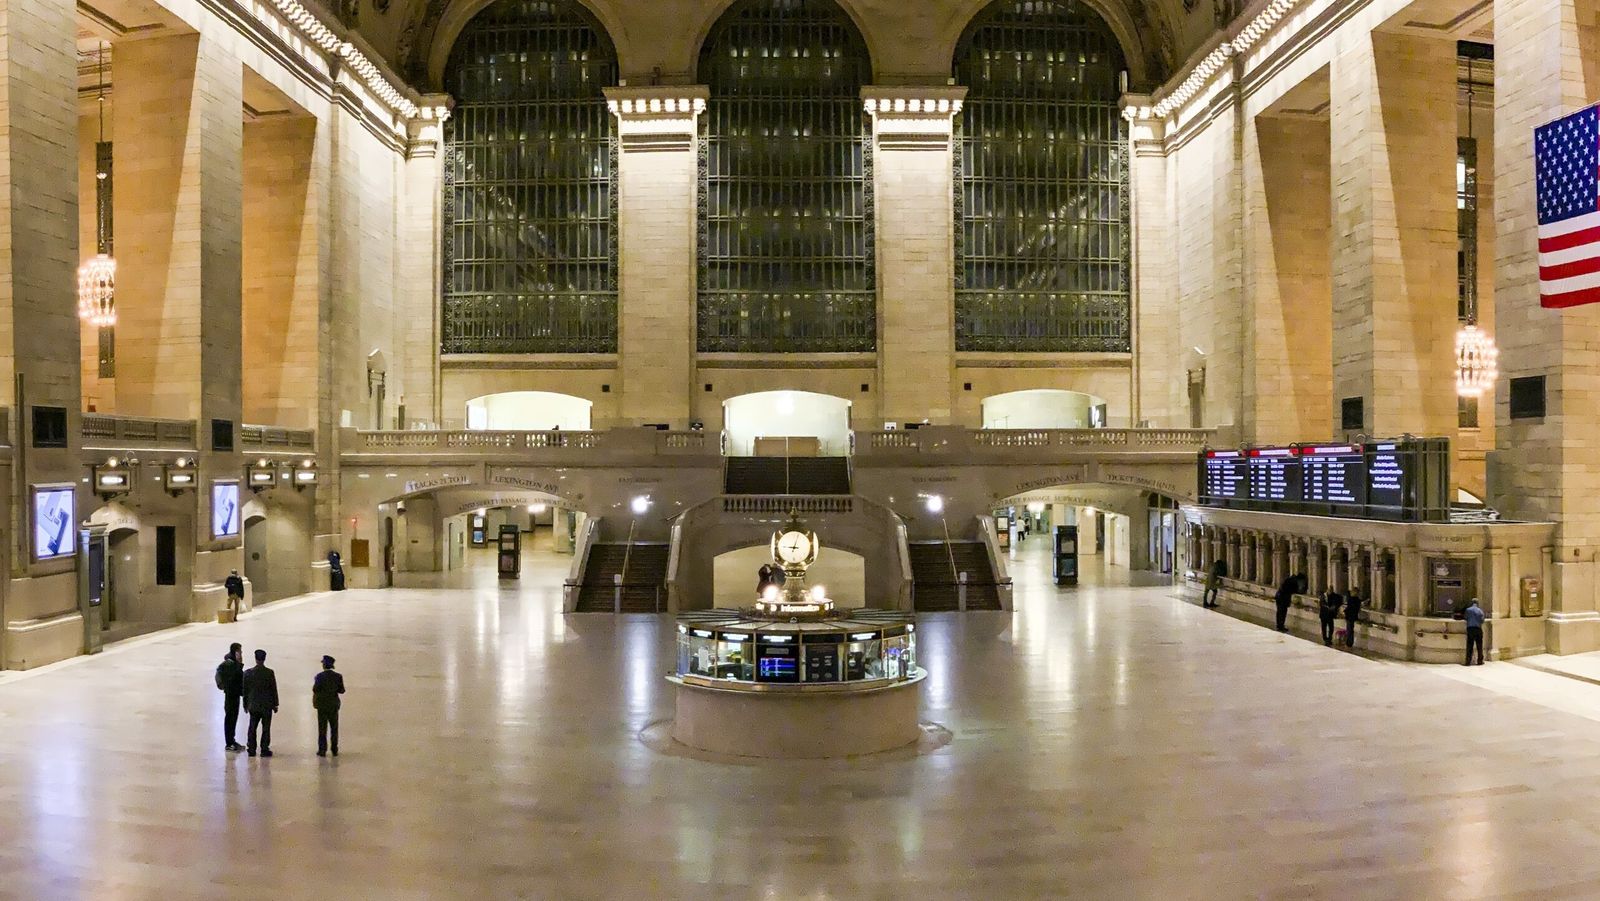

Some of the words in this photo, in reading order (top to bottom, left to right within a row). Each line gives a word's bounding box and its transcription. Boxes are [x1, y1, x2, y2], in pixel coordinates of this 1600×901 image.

[408, 479, 438, 491] TRACKS
[447, 475, 460, 483] TO
[495, 475, 542, 489] LEXINGTON
[1016, 477, 1063, 490] LEXINGTON
[1105, 474, 1133, 482] TICKET
